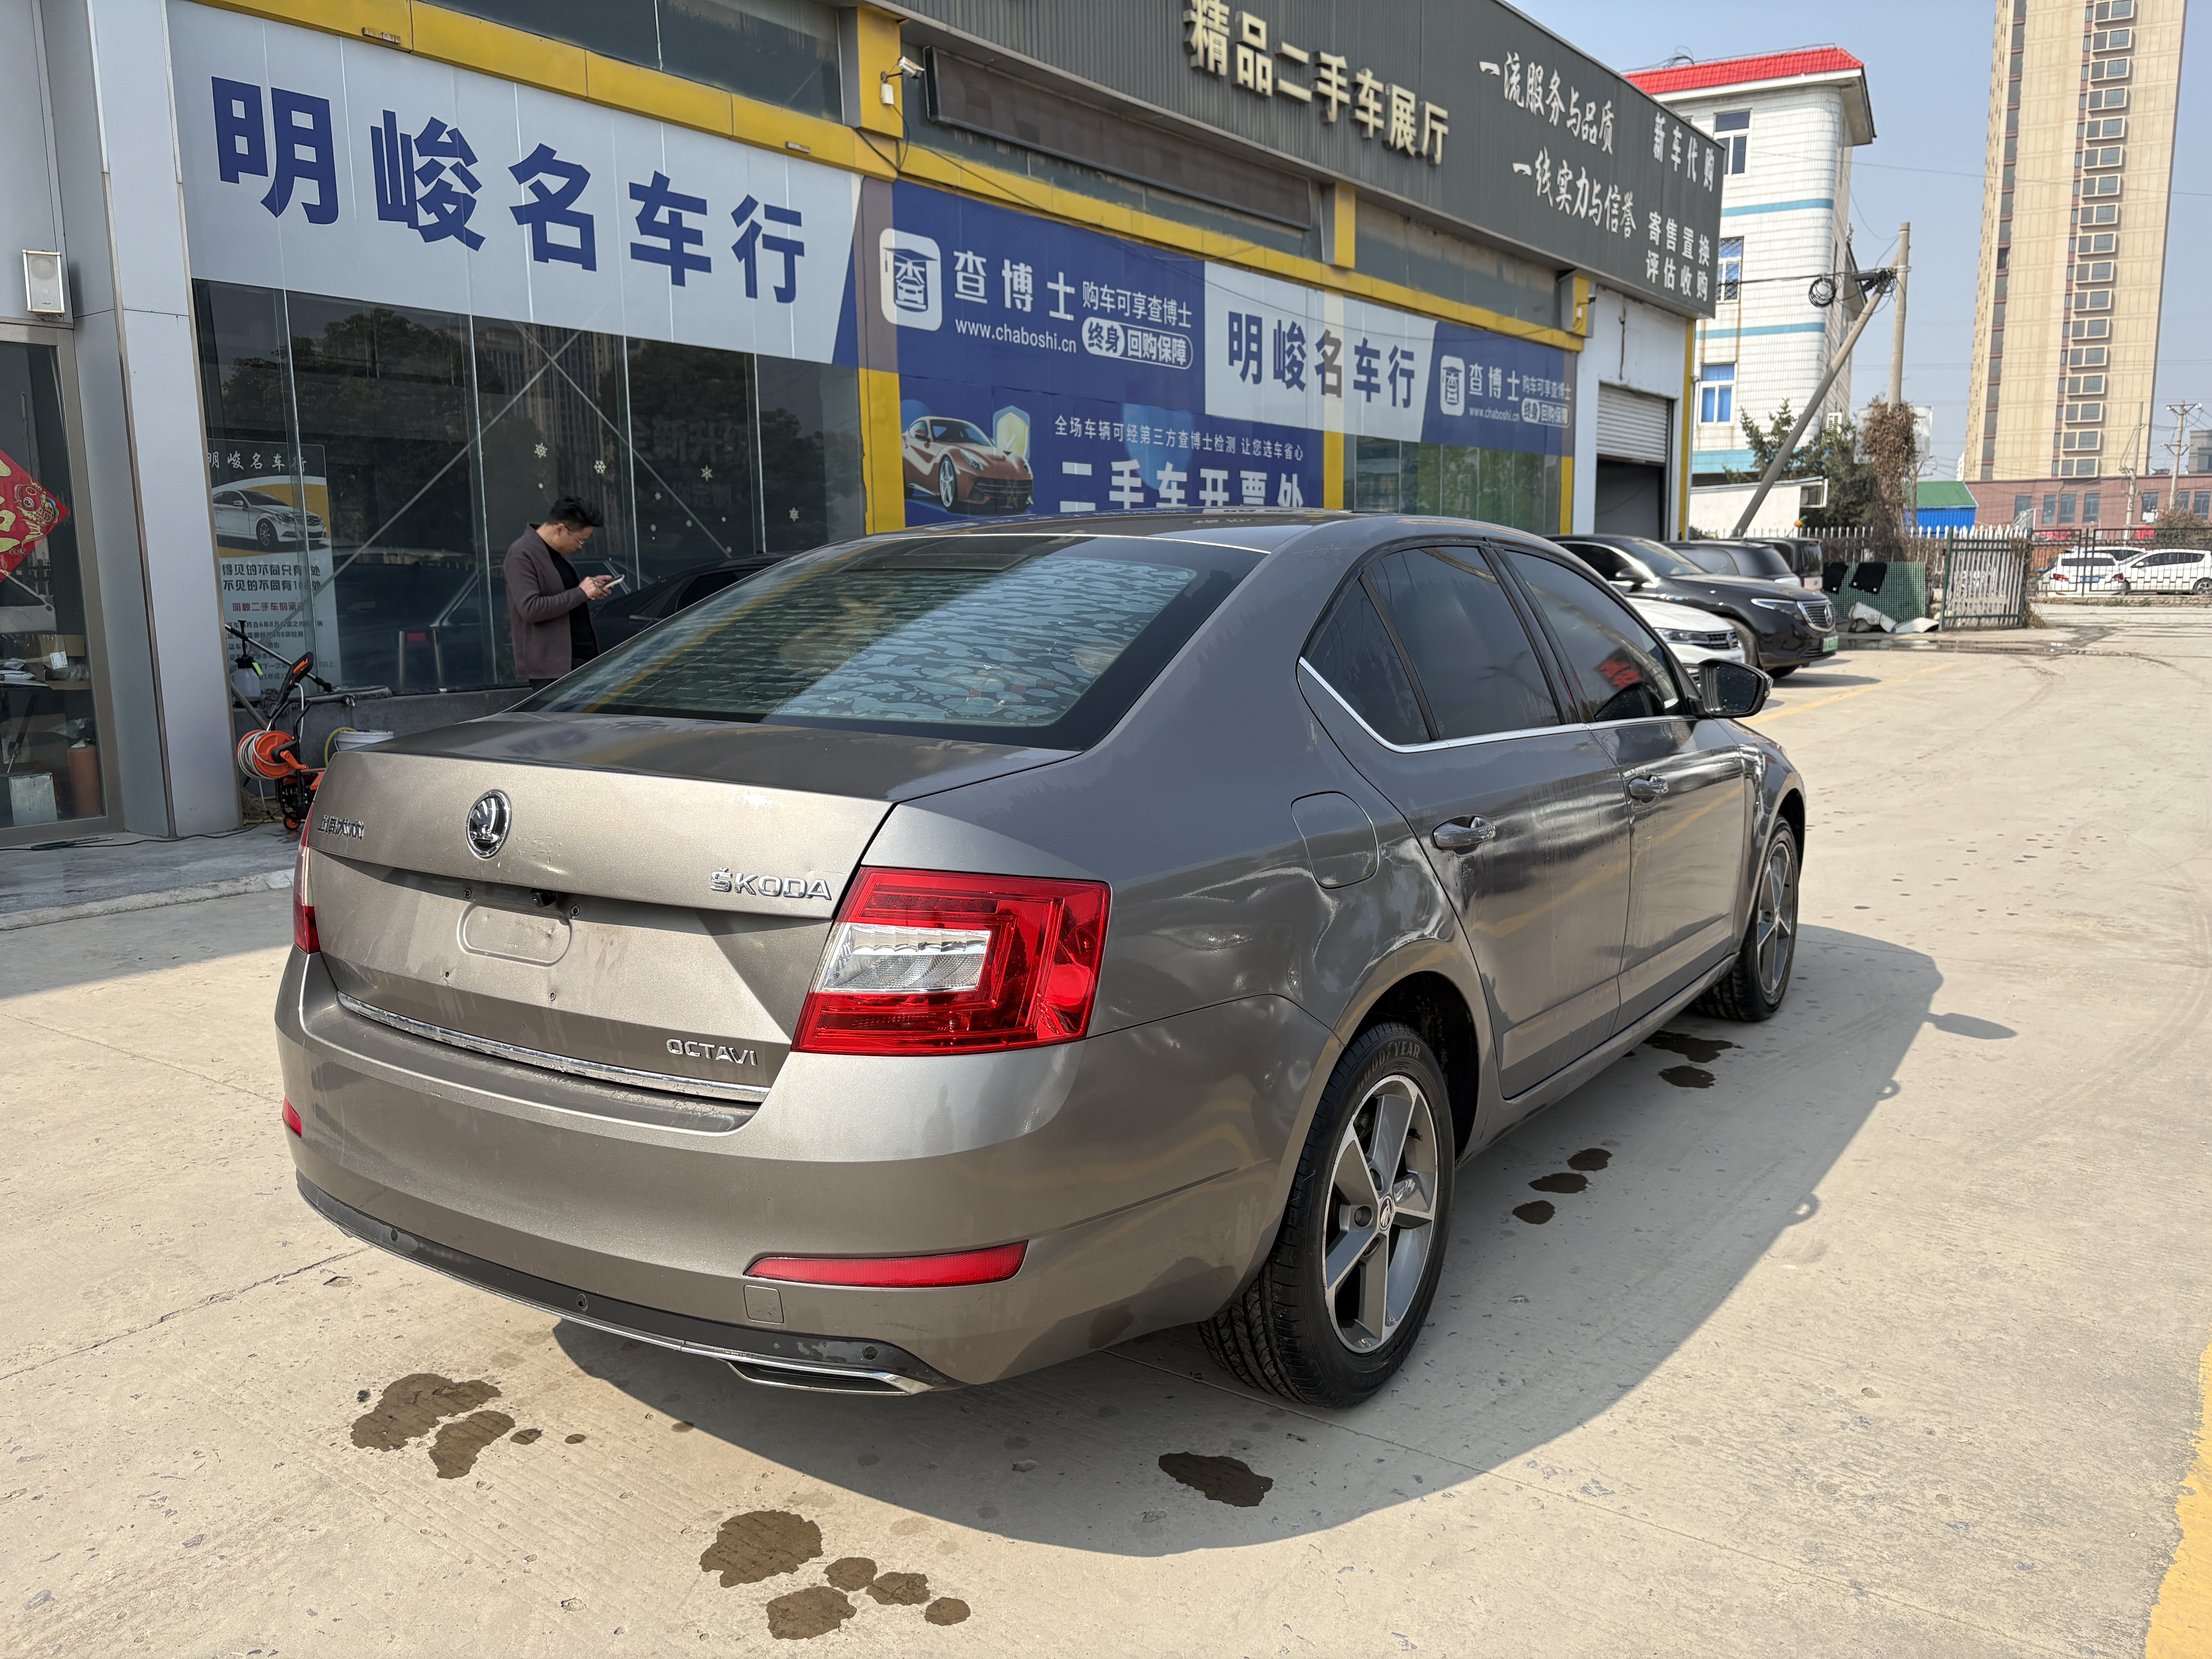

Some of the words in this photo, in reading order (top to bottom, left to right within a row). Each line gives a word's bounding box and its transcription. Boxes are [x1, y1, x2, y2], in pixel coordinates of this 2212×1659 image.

[1184, 0, 1448, 165] 精品二手车展厅
[1479, 51, 1614, 155] 一流服务与品质
[1653, 112, 1714, 192] 新车代购
[211, 77, 804, 303] 明峻名车行
[1513, 146, 1637, 239] 一线实力与信誉
[1649, 211, 1710, 267] 寄售置换
[953, 250, 1075, 321] 查博士
[1646, 249, 1707, 302] 评估收购
[1082, 281, 1192, 328] 购车可享查博士
[955, 319, 1077, 353] www.chaboshi.cn
[1088, 321, 1120, 354] 终身
[1127, 329, 1187, 365] 回购保障
[1228, 311, 1415, 408] 明峻名车行
[1469, 363, 1520, 402] 查博士
[1054, 415, 1236, 454] 全场车辆可经第三方查博士检测
[1241, 437, 1303, 461] 让您选车省心
[1060, 459, 1304, 512] 二手车开票处
[222, 564, 321, 576] 得见的不同只有处
[710, 867, 832, 900] ŠKODA
[666, 1039, 758, 1066] OCTAVI
